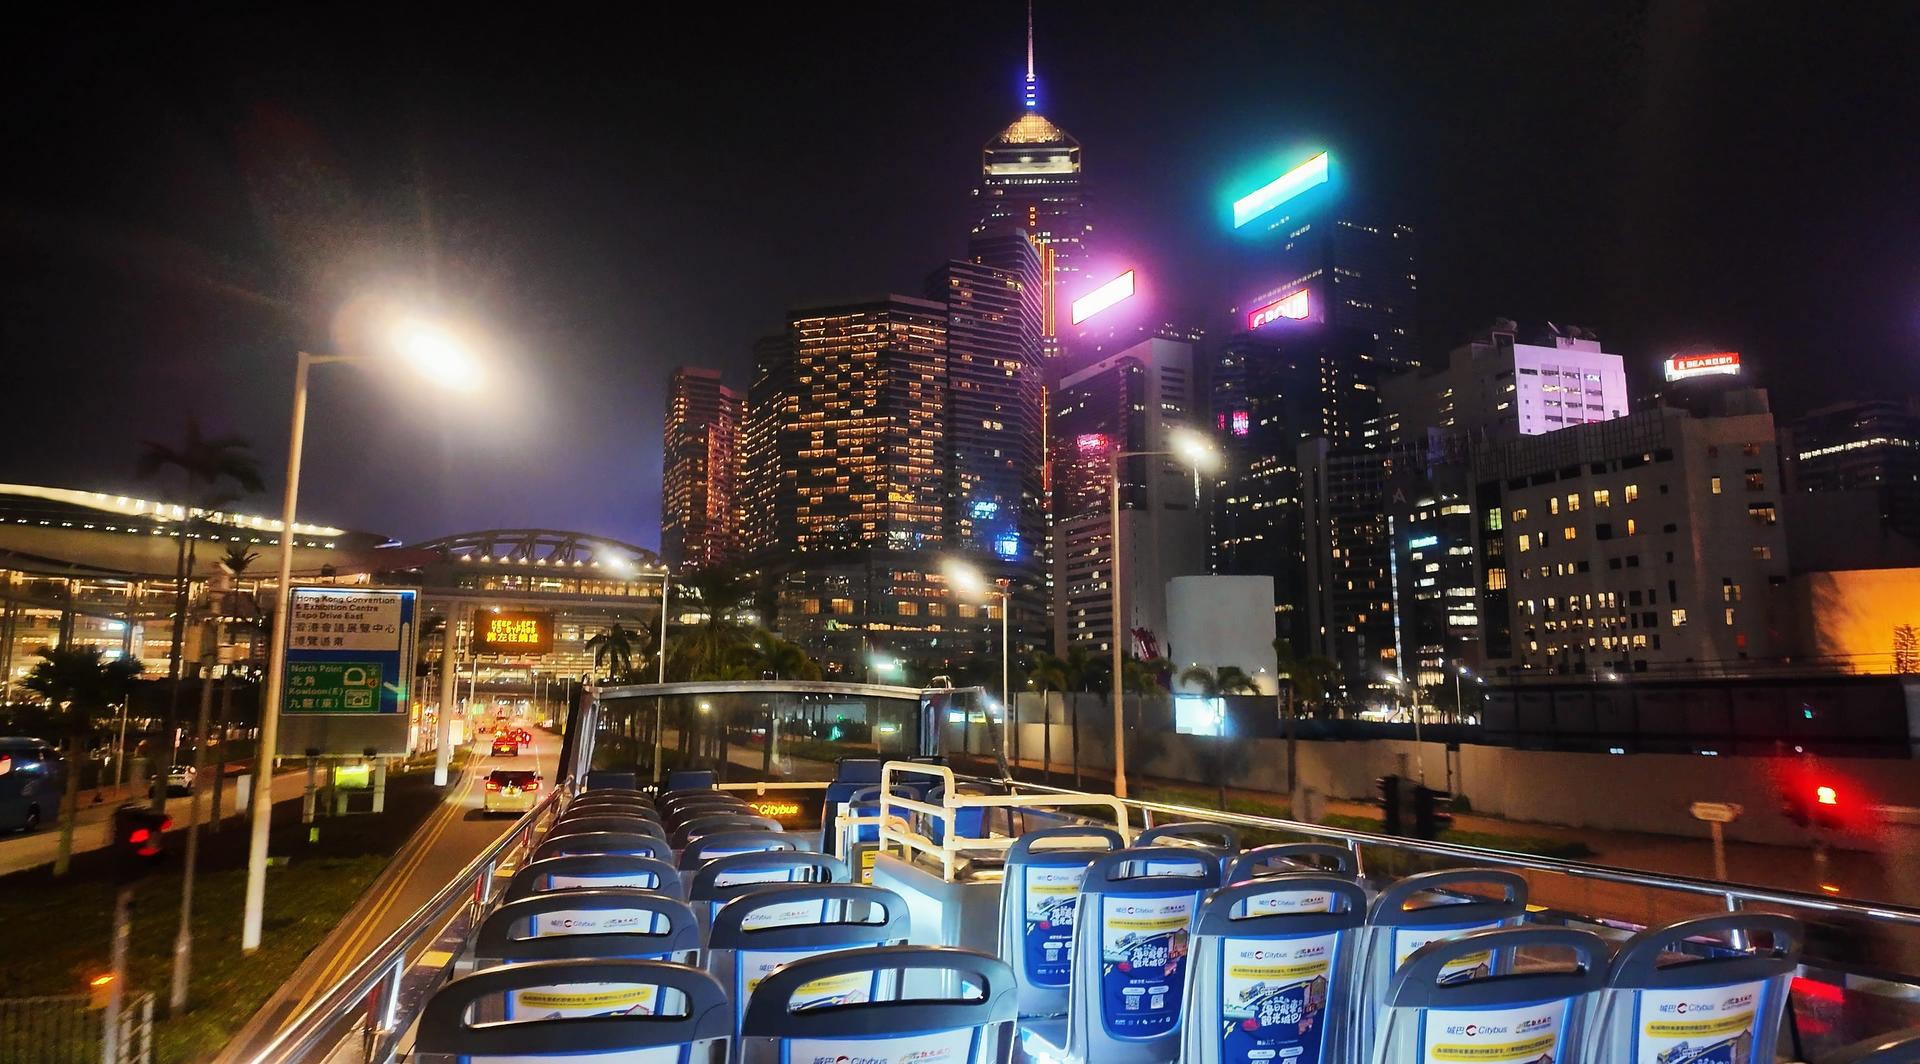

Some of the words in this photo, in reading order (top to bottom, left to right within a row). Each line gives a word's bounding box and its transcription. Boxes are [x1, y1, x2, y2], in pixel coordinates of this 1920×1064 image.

[1686, 360, 1705, 368] BEA
[296, 595, 319, 604] Hong
[321, 595, 343, 604] Kong
[346, 596, 395, 604] Convention
[303, 604, 347, 612] Exhibition
[349, 604, 379, 612] Centre
[295, 612, 318, 620] Expo
[319, 612, 342, 620] Drive
[344, 612, 364, 620] East
[295, 622, 396, 634] 香港會議展覽中心
[290, 664, 317, 673] North
[319, 664, 343, 673] Point
[291, 675, 316, 686] 北角
[289, 688, 344, 696] Kowloon(E)
[759, 803, 799, 816] Citybus
[1240, 950, 1254, 959] 城巴
[1264, 950, 1288, 959] Citybus
[1659, 1003, 1676, 1013] 城巴
[1688, 1003, 1714, 1012] Citybus
[1447, 1025, 1465, 1035] 城巴
[1478, 1025, 1508, 1035] Citybus
